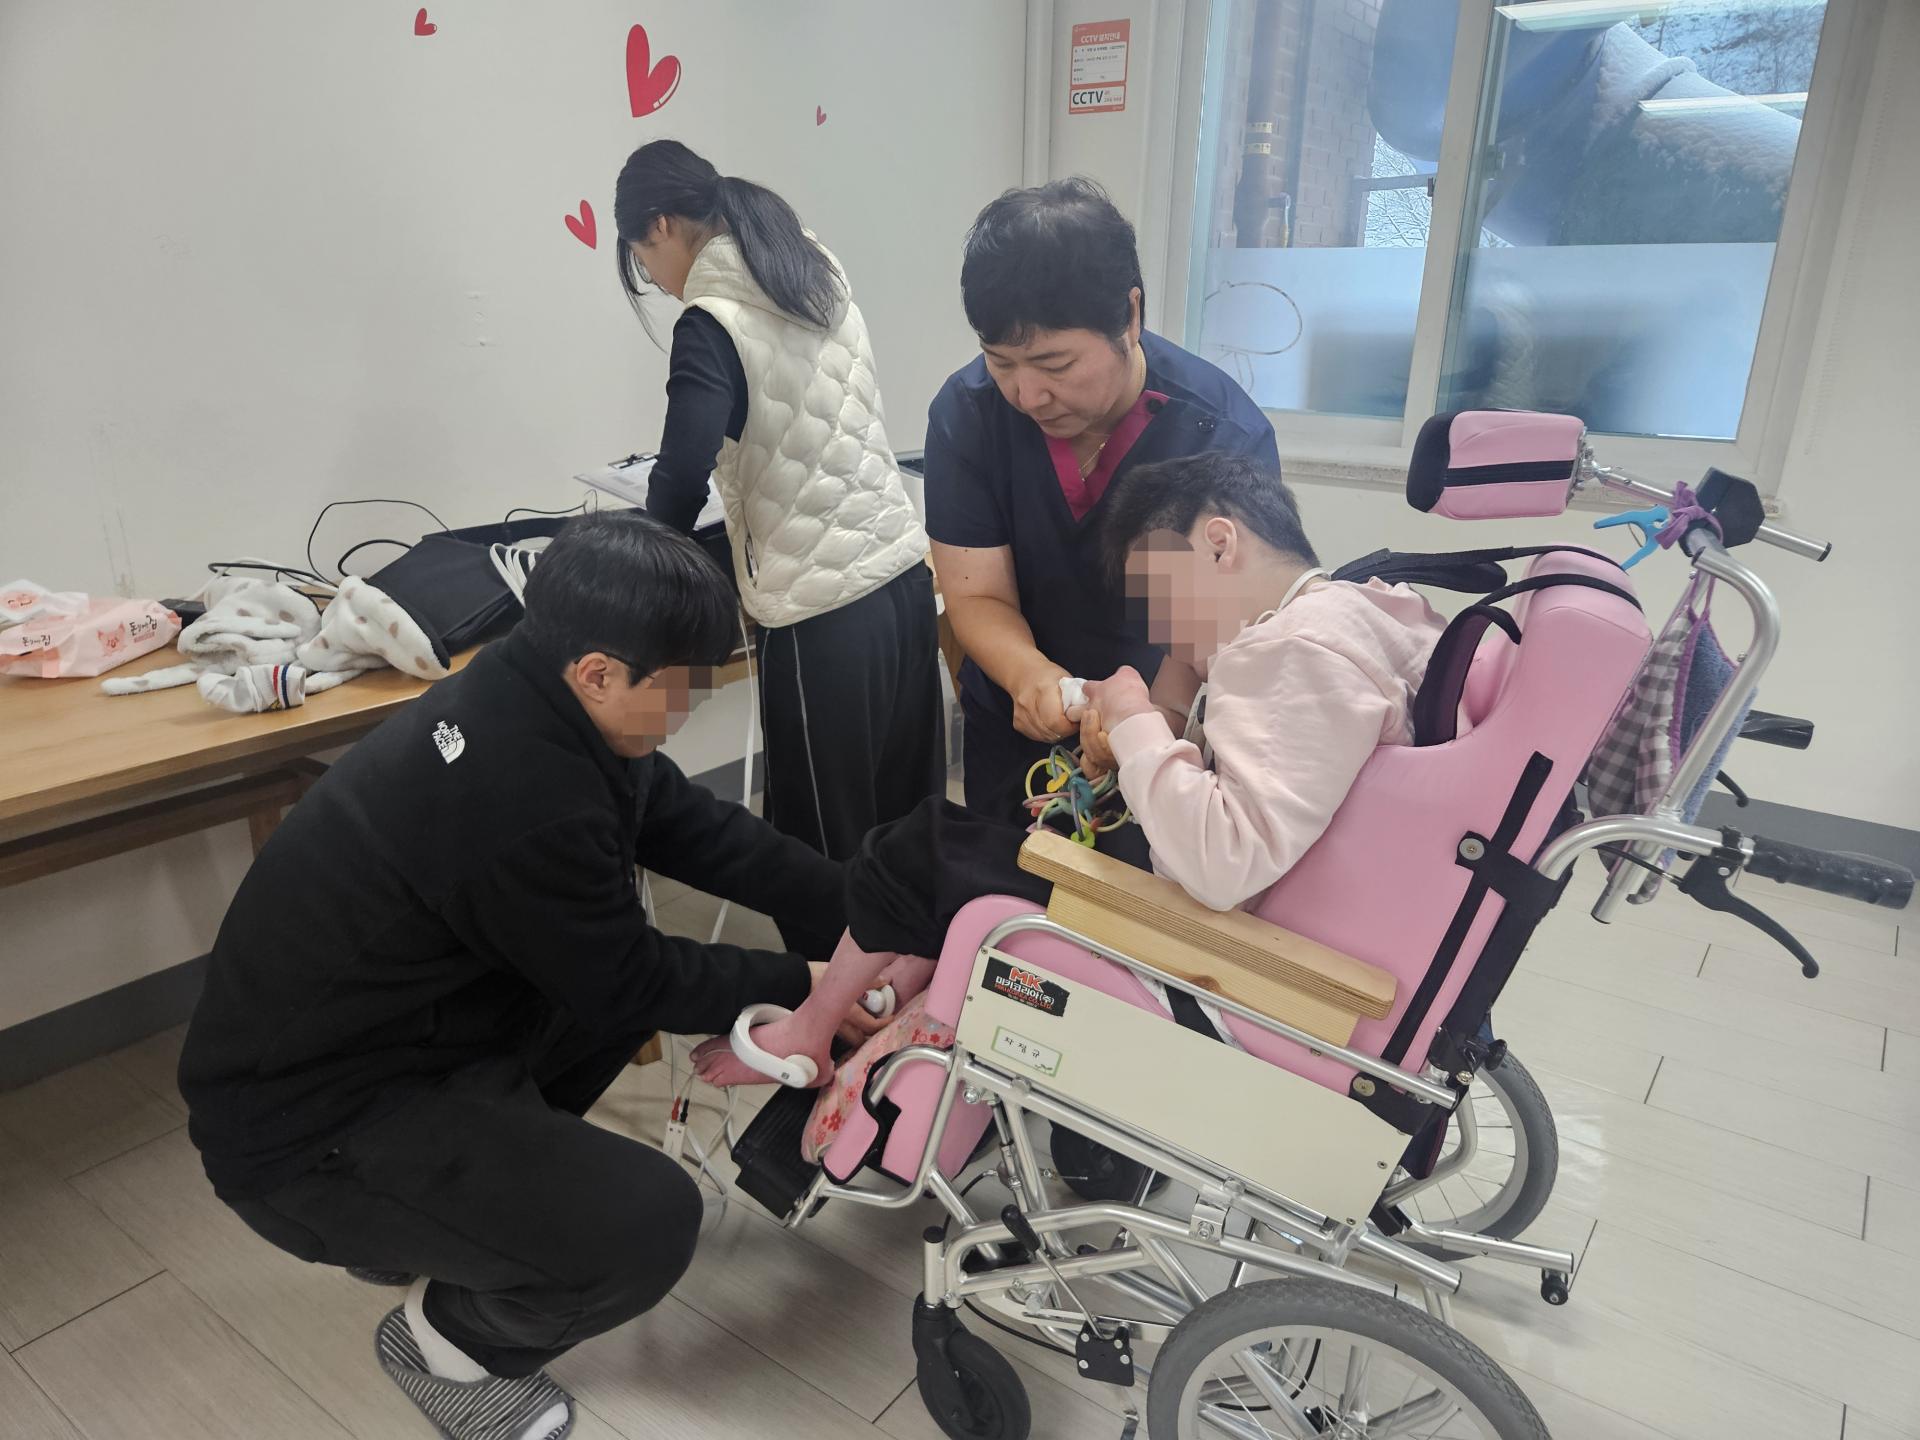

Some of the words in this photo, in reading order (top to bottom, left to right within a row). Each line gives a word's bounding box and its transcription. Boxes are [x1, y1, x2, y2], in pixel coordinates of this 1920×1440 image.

[1072, 91, 1103, 105] CCTV
[432, 730, 449, 751] FACE
[437, 720, 455, 746] NORTH
[450, 724, 463, 742] THE
[1009, 966, 1045, 993] MK
